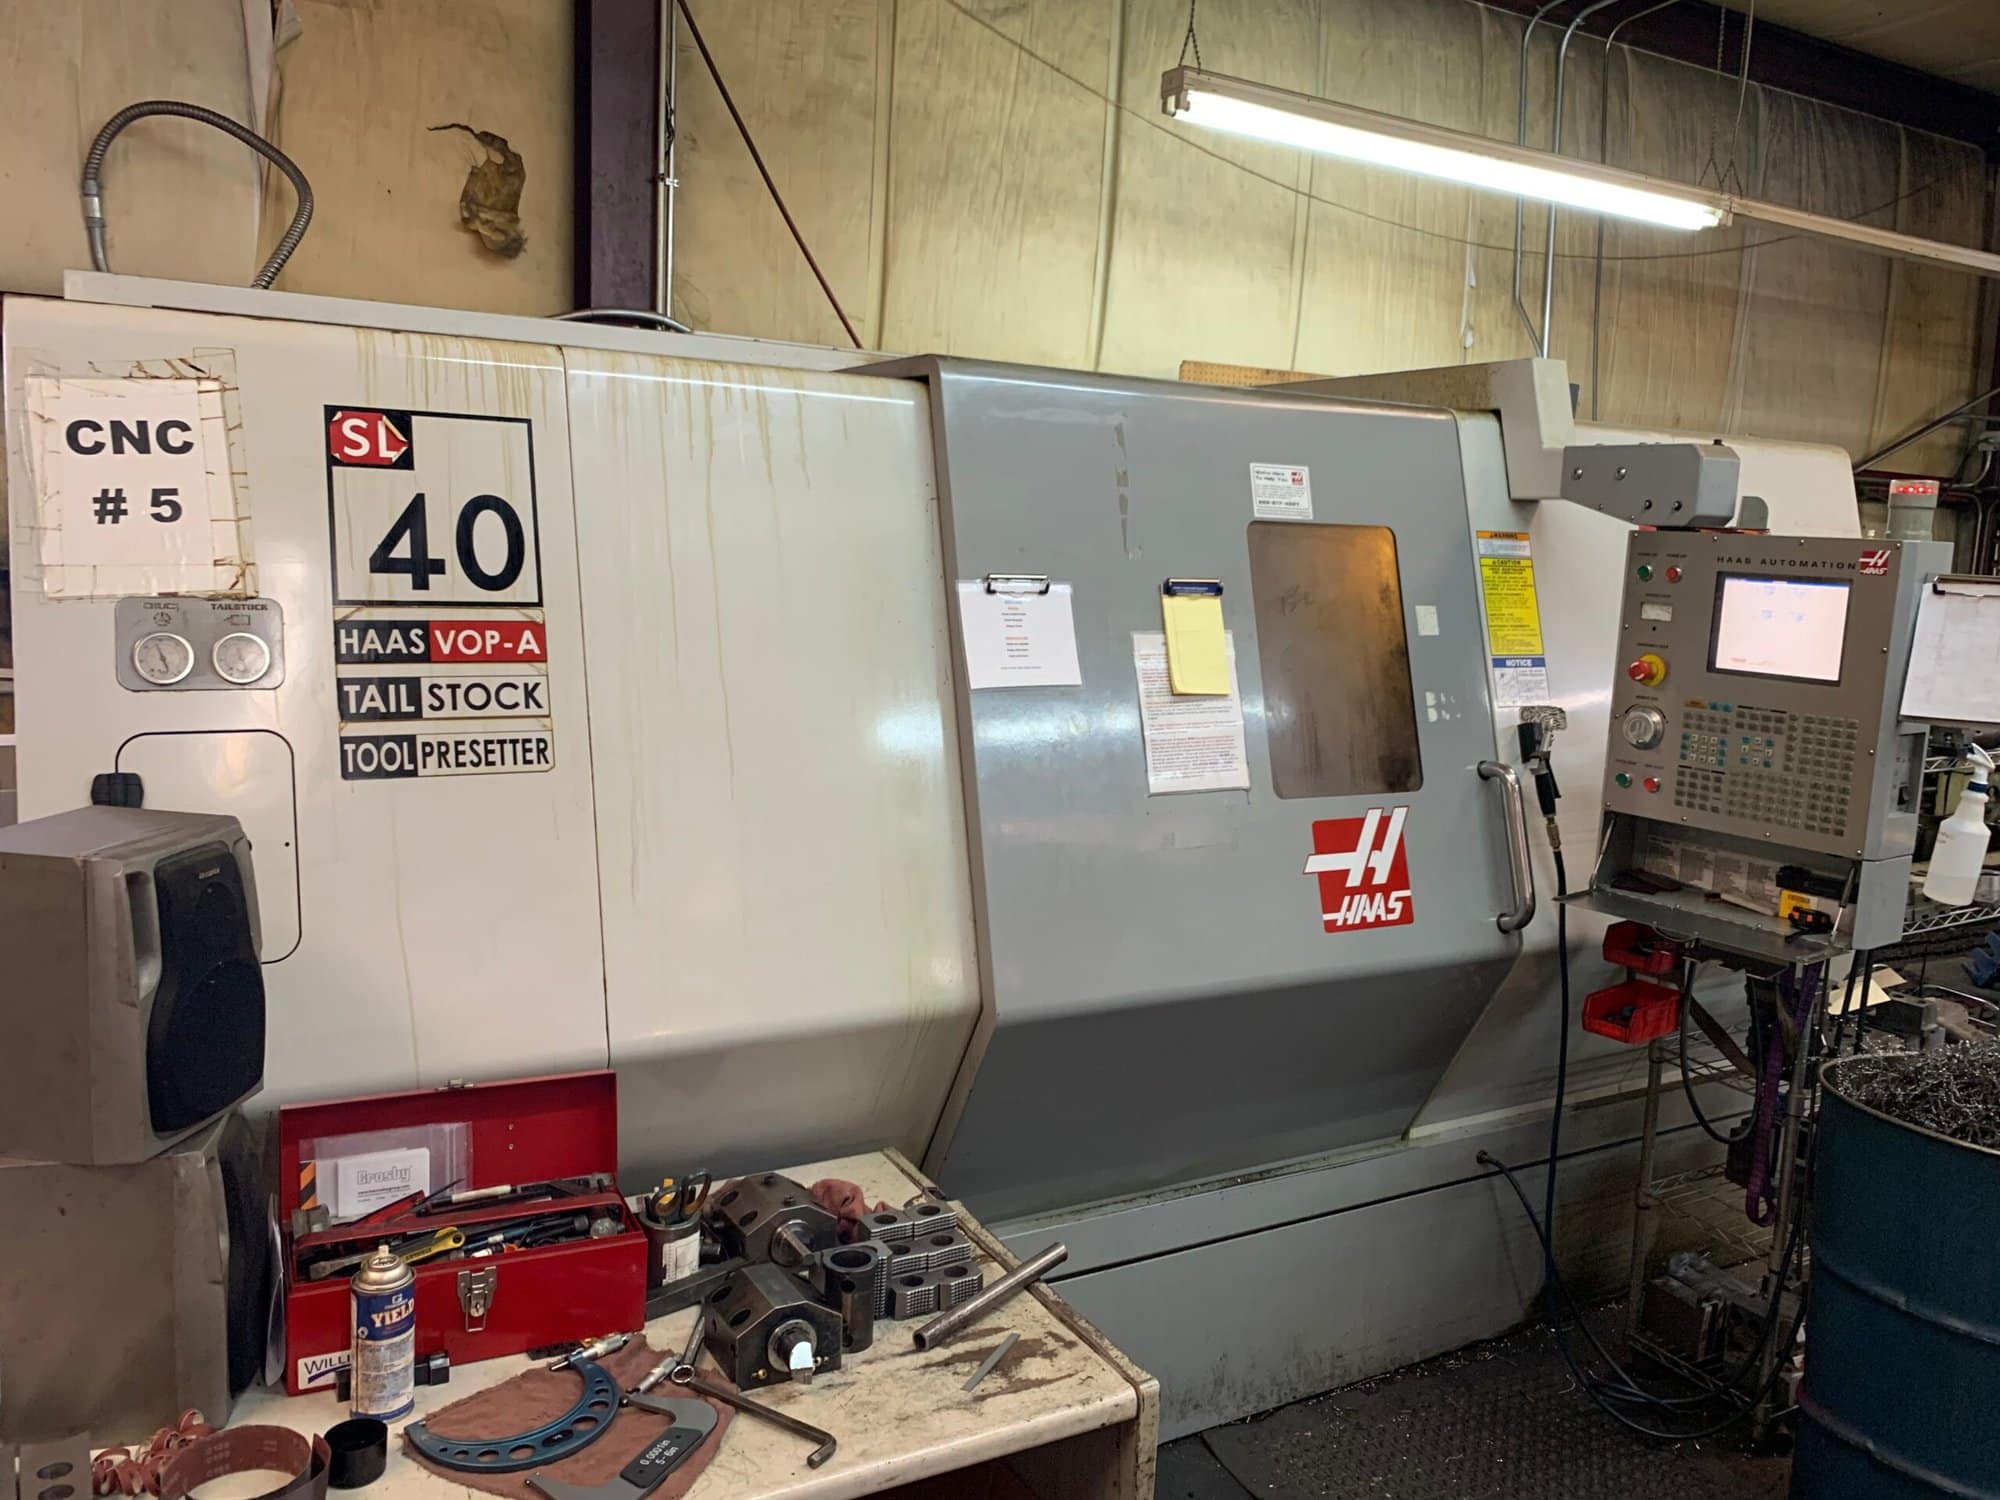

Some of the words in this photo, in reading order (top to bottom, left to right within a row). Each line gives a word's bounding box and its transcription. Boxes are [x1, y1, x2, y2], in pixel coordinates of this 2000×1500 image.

[65, 419, 194, 456] CNC
[341, 417, 401, 459] SL
[92, 488, 128, 525] #
[150, 488, 183, 523] 5
[369, 492, 525, 592] 40
[1717, 556, 1751, 565] HAAS
[1760, 557, 1857, 570] AUTOMATION
[339, 628, 426, 655] HAAS
[434, 629, 541, 655] VOP-A
[1505, 659, 1532, 667] NOTICE
[343, 684, 416, 714] TAIL
[427, 682, 544, 712] STOCK
[343, 741, 415, 773] TOOL
[421, 737, 550, 770] PRESETTER
[1322, 889, 1412, 926] HAAS
[370, 1297, 415, 1328] YIELD
